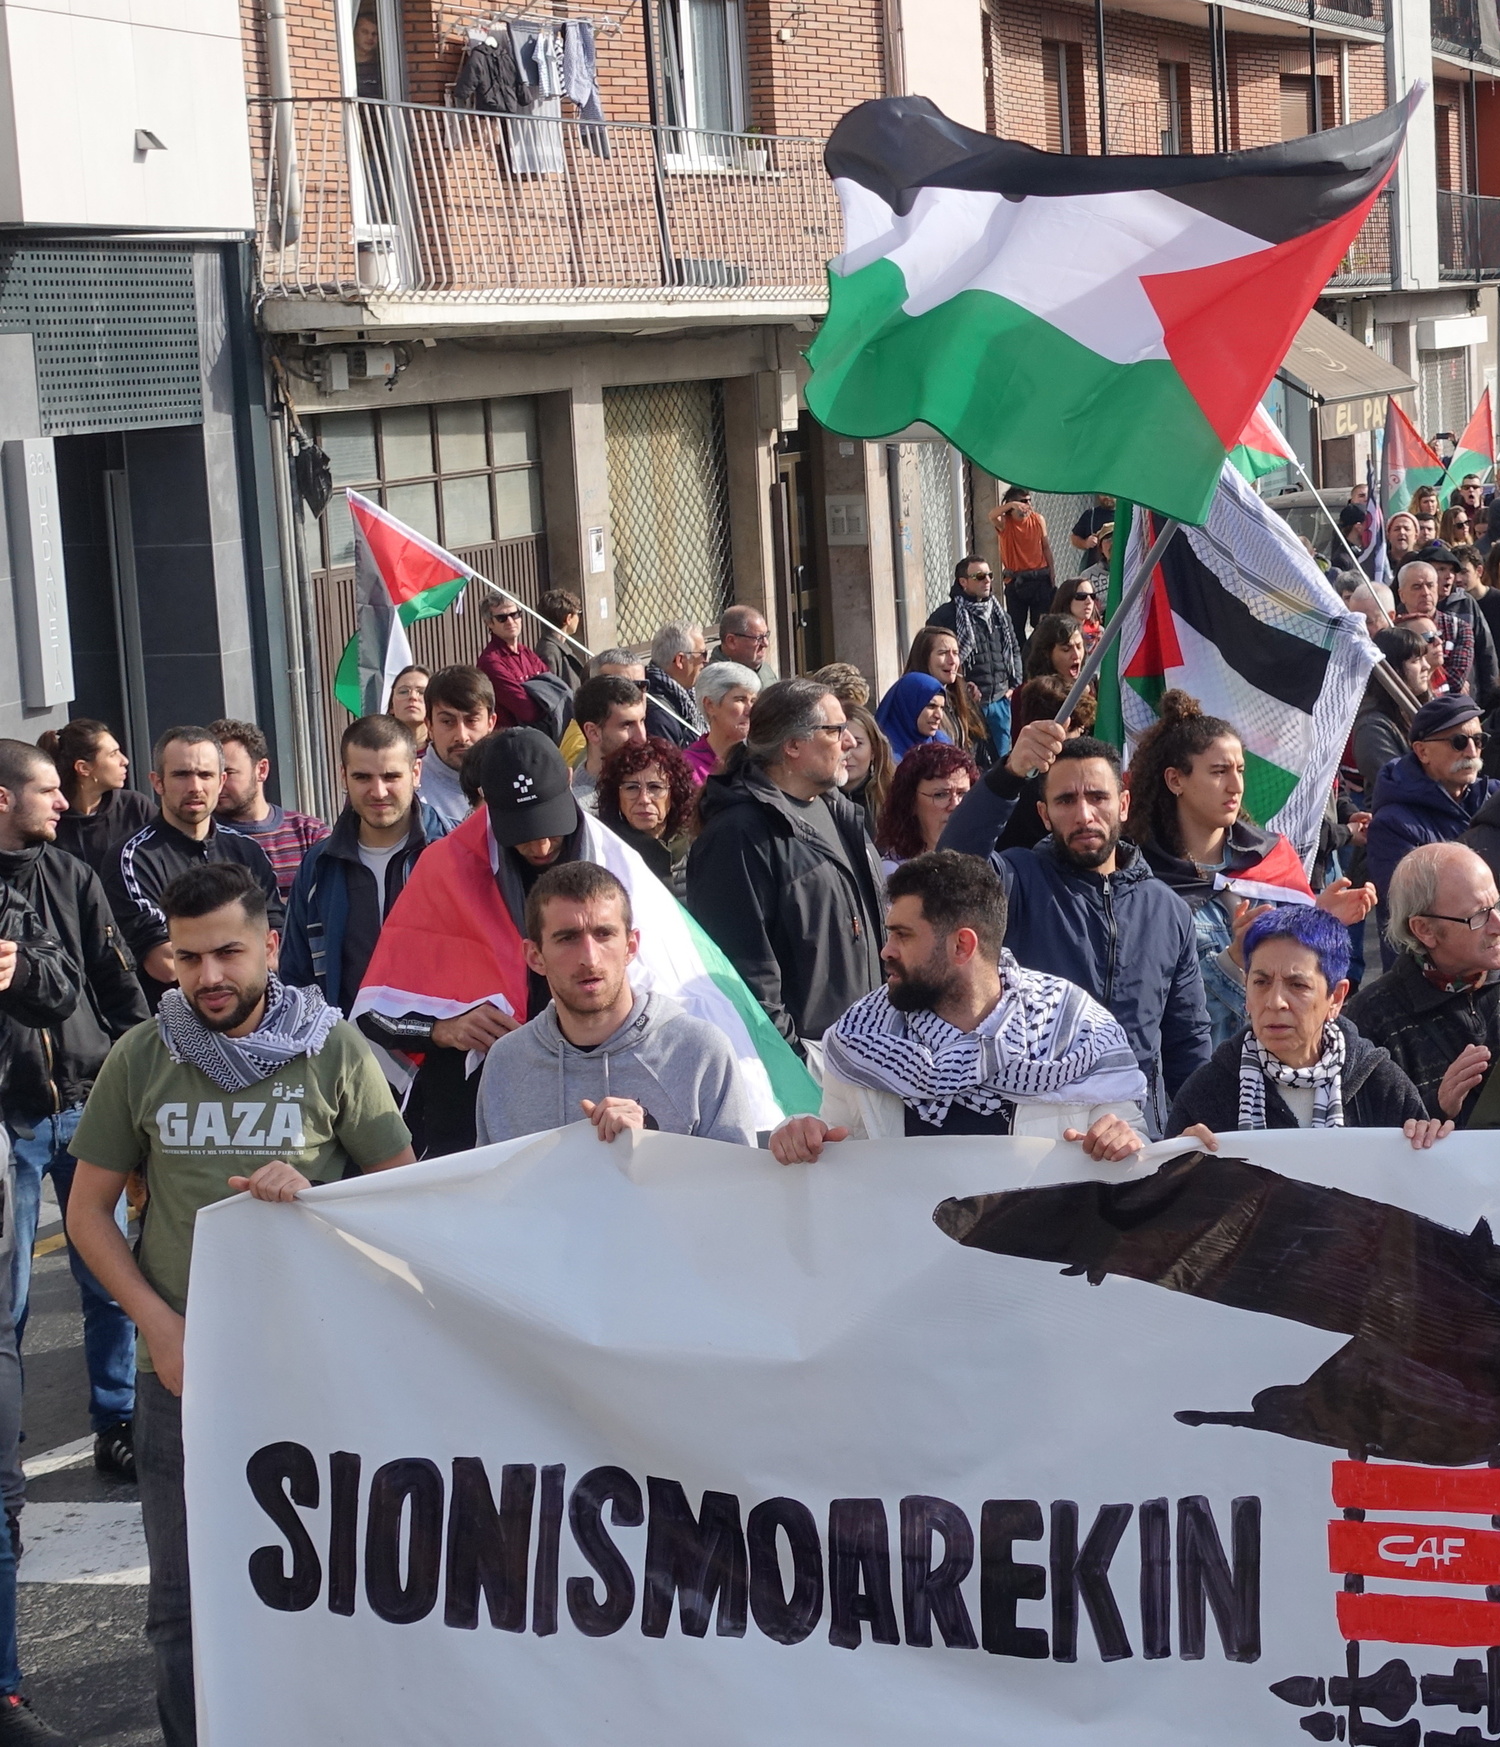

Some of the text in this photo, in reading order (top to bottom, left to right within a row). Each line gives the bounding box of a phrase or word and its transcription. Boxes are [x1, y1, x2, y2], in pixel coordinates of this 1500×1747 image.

[1336, 403, 1358, 435] EL
[38, 486, 65, 691] URDANETA
[272, 1082, 305, 1101] غزة
[156, 1102, 305, 1147] GAZA
[246, 1441, 1262, 1664] SIONISMOAREKIN
[1377, 1535, 1465, 1568] CAF
